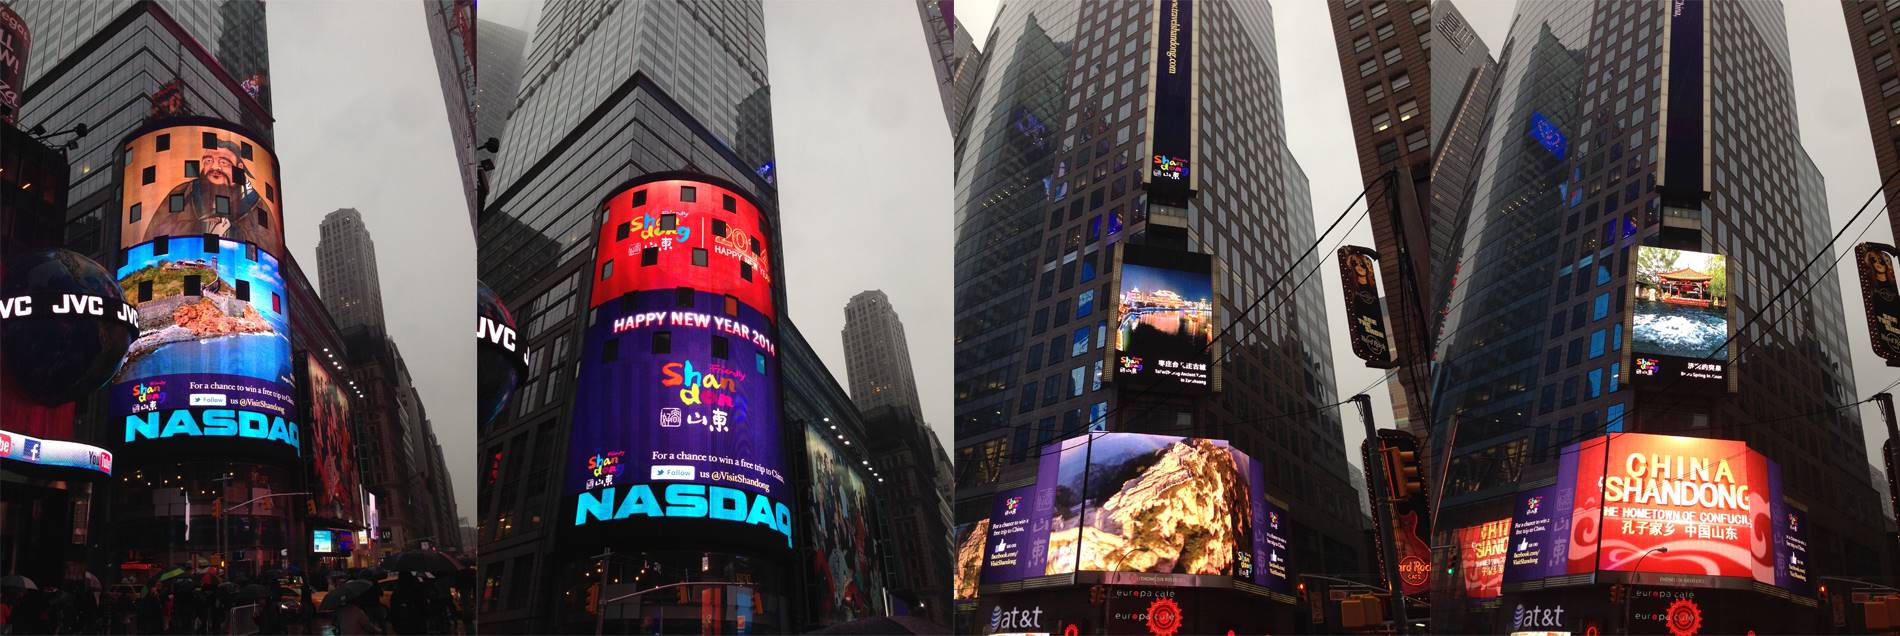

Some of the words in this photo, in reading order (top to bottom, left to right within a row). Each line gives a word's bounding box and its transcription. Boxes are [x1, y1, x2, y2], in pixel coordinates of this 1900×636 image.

[714, 245, 742, 262] HAPPY
[715, 223, 769, 272] 204
[0, 295, 32, 319] VC
[52, 294, 104, 316] JVC
[117, 303, 139, 329] JVC
[477, 316, 516, 352] JVC
[614, 311, 667, 333] HAPPY
[671, 311, 711, 329] NEW
[713, 316, 750, 340] YEAR
[752, 330, 775, 357] 2014
[662, 360, 736, 393] Shan
[190, 382, 203, 390] For
[210, 382, 236, 391] chance
[245, 385, 257, 393] win
[262, 387, 273, 396] free
[239, 398, 285, 415] @VisitShandong
[125, 409, 300, 457] NASDAQ
[588, 453, 618, 470] Shan
[652, 451, 668, 460] For
[676, 451, 707, 461] chance
[709, 454, 717, 462] to
[719, 456, 733, 465] win
[740, 458, 753, 469] free
[754, 464, 765, 475] trip
[1626, 452, 1735, 483] CHINA
[667, 469, 691, 477] Follow
[711, 471, 770, 492] @VisitShandong
[1605, 476, 1750, 511] SHANDONG
[575, 484, 793, 549] NASDAQ
[1603, 506, 1618, 517] HE
[1622, 507, 1680, 523] HOMETOWN
[1682, 511, 1696, 522] OF
[1699, 512, 1752, 526] CONFUCIU
[1622, 521, 1675, 537] 孔子家乡
[1684, 523, 1738, 541] 中国山东
[1399, 561, 1412, 572] ard
[1413, 561, 1431, 573] Roc
[1116, 590, 1152, 599] europa
[1636, 590, 1671, 599] europa
[1000, 606, 1043, 629] at&t
[1115, 613, 1151, 622] europa
[1523, 605, 1564, 627] at&t
[1635, 613, 1671, 622] europa
